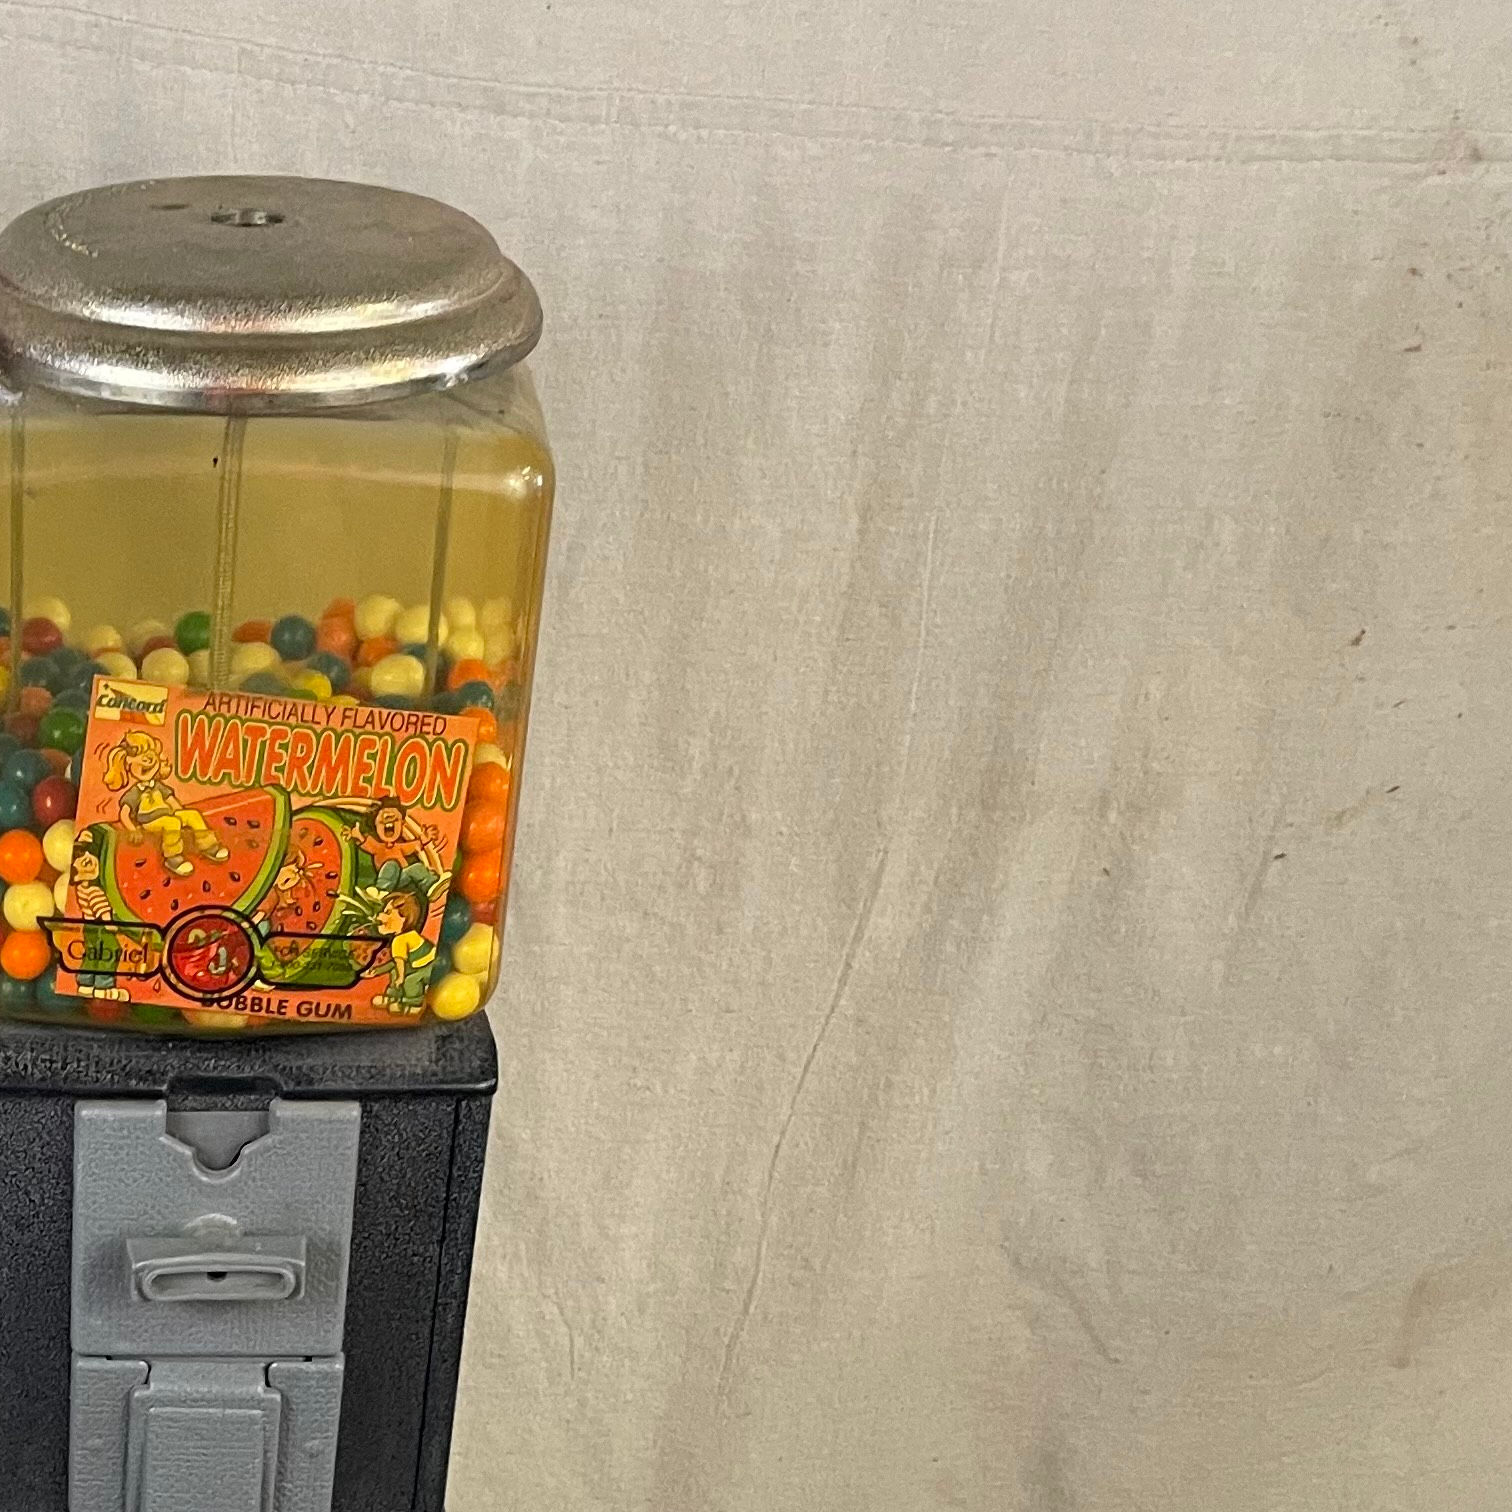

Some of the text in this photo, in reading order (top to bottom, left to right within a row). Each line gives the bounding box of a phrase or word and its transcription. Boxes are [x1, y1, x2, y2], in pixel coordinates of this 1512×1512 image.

[202, 692, 448, 736] ARTIFICIALLY FLAVORED
[174, 712, 470, 811] WATERMELON
[67, 940, 149, 964] Gabriel
[296, 1001, 353, 1020] GUM
